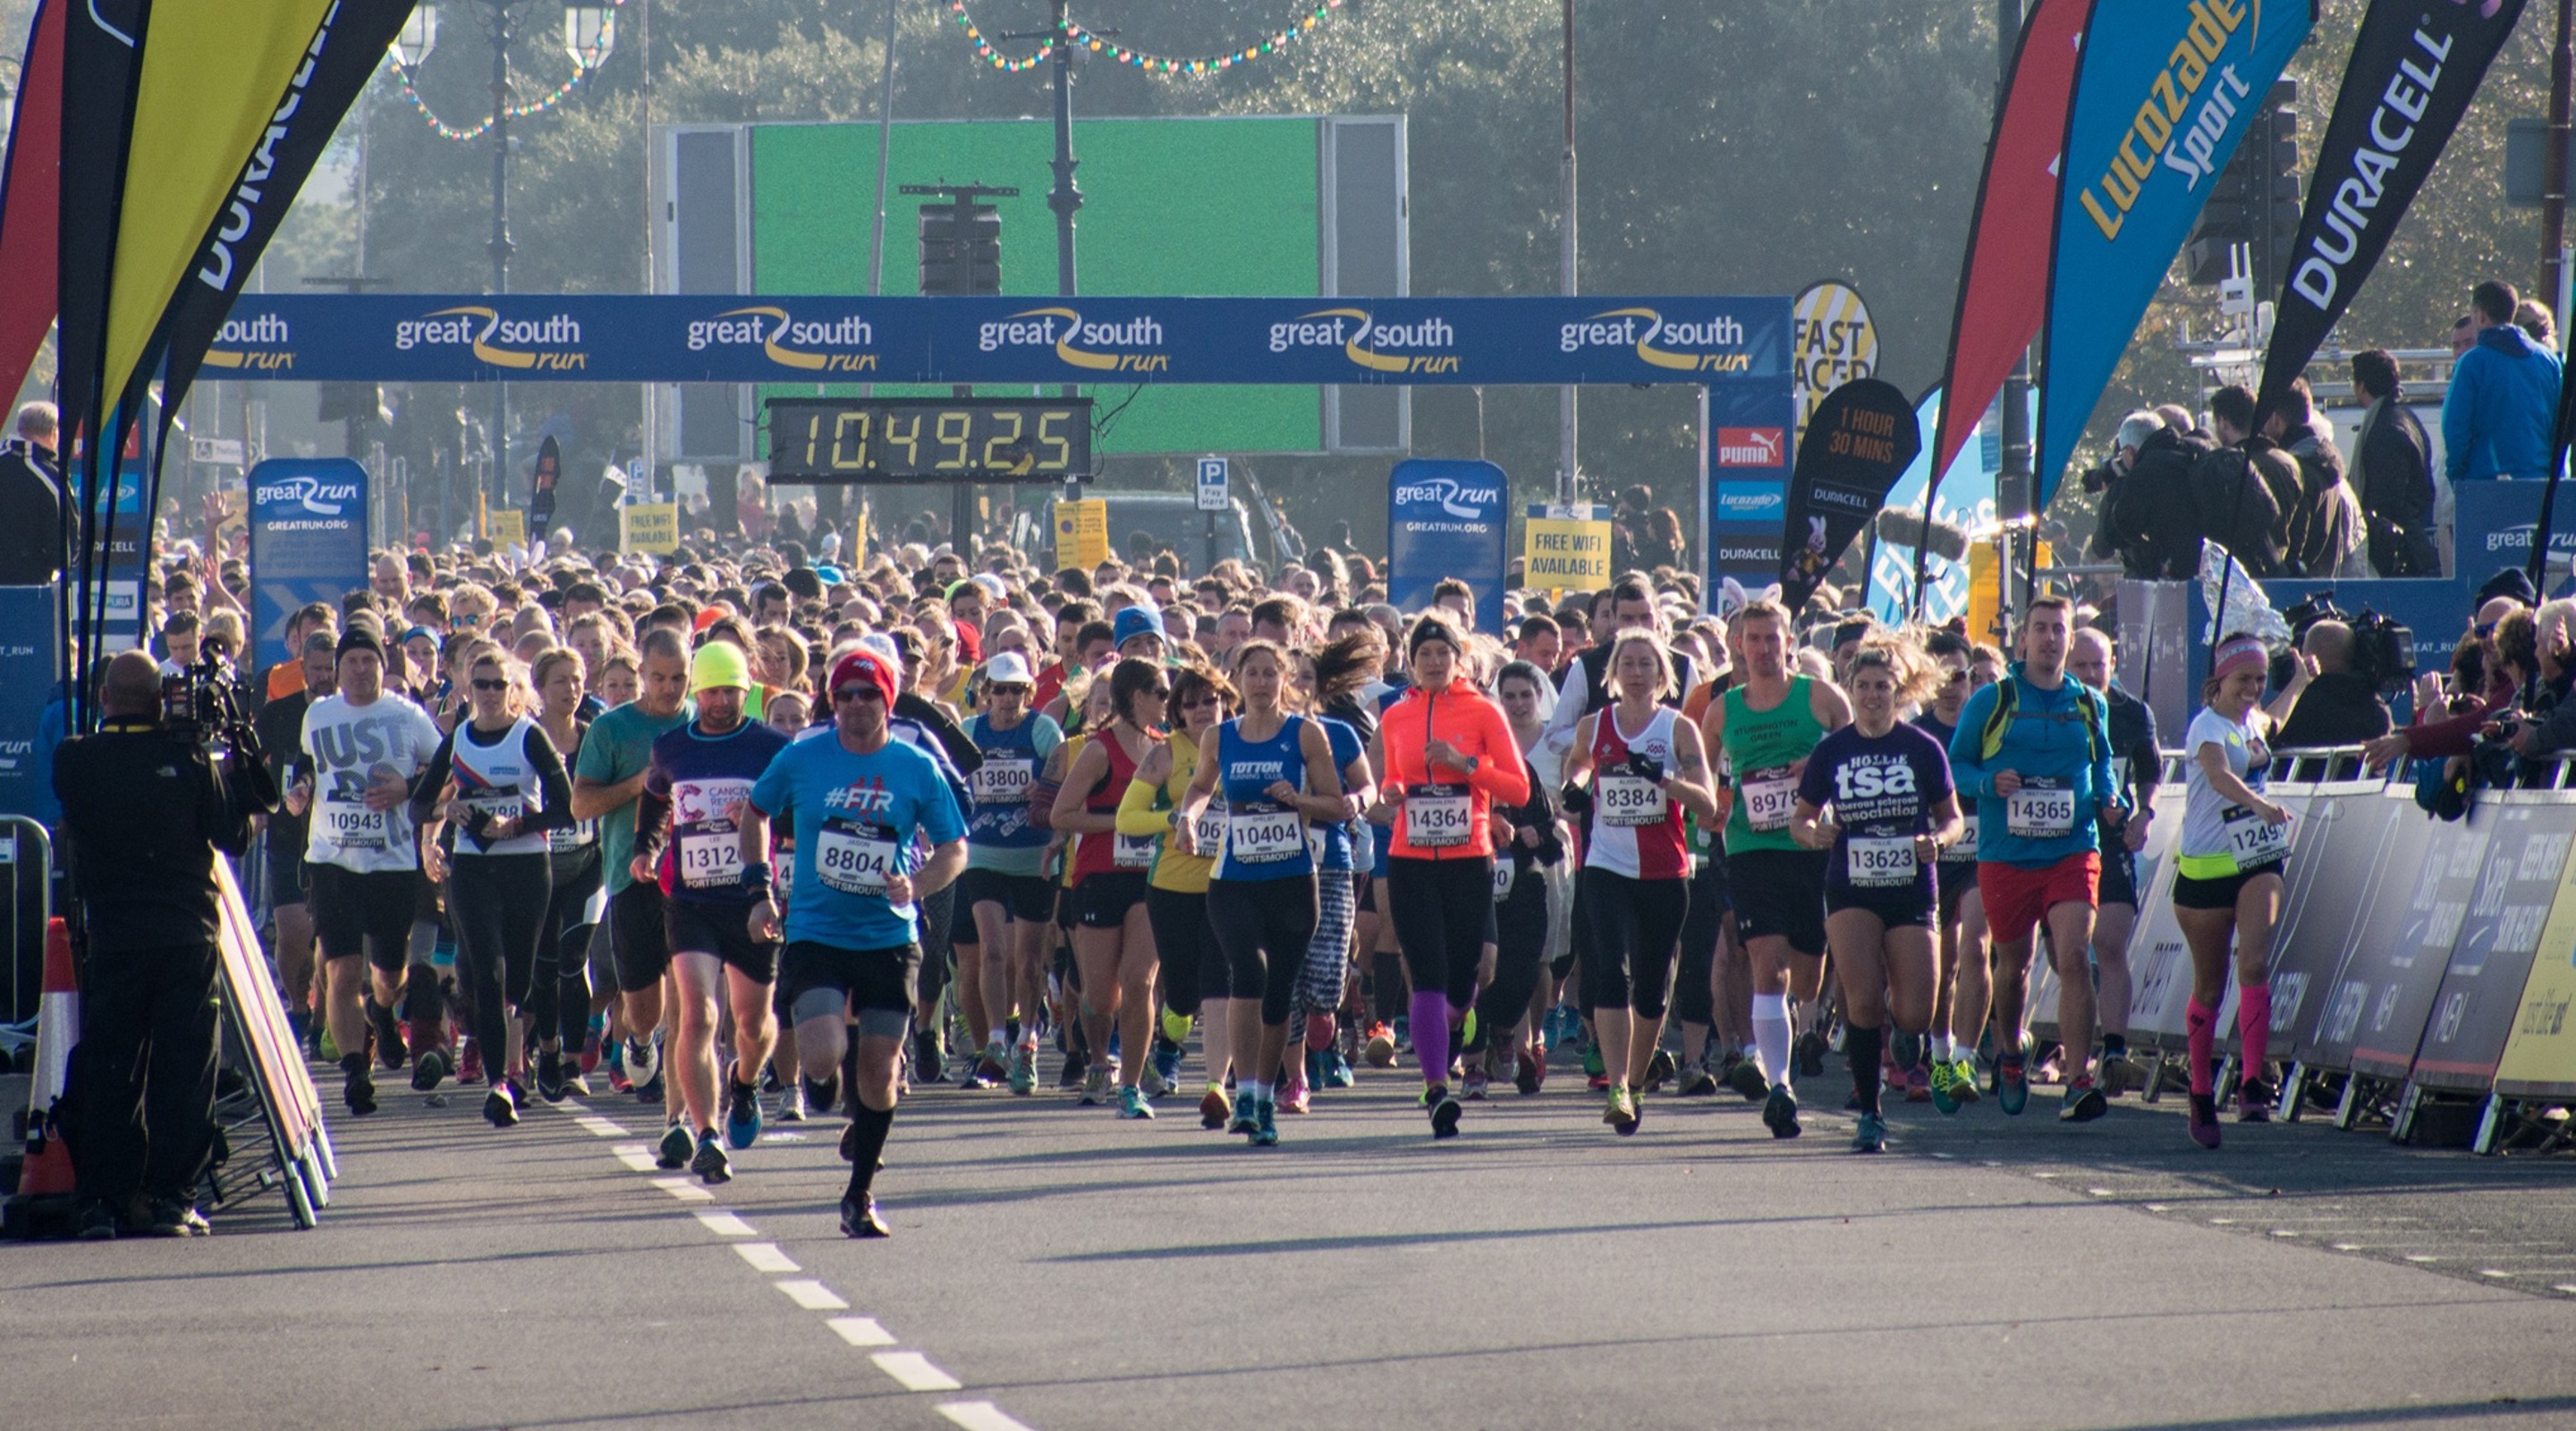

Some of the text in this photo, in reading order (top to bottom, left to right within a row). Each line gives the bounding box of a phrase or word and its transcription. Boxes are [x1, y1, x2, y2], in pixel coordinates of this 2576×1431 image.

[2080, 0, 2247, 242] Lucozade
[2164, 63, 2250, 193] Sport
[2292, 29, 2454, 312] DURACELL
[396, 314, 580, 350] great south
[688, 317, 872, 350] great south
[979, 317, 1162, 350] great south
[1270, 317, 1453, 352] great south
[1561, 317, 1743, 352] great south
[1794, 319, 1865, 357] FAST
[243, 352, 294, 369] run
[538, 352, 587, 369] run
[827, 354, 877, 372] run
[1120, 354, 1169, 372] run
[1411, 355, 1460, 374] run
[1700, 353, 1750, 371] run
[1794, 358, 1871, 394] ACED
[1852, 409, 1894, 437] HOUR
[804, 411, 1072, 470] 10.49.25
[1829, 431, 1894, 465] 30 MINS
[1720, 447, 1768, 463] PUMA
[1206, 463, 1222, 484] P
[256, 483, 357, 505] great run
[1205, 488, 1222, 497] Pay
[1395, 484, 1498, 505] great run
[1814, 488, 1868, 509] DURACELL
[267, 520, 348, 531] GREATRUN.ORG
[1406, 521, 1487, 534] GREATRUN.ORG
[1535, 533, 1601, 552] FREE WIFI
[2487, 529, 2576, 552] great ru
[1720, 548, 1781, 560] DURACELL
[1530, 557, 1605, 577] AVAILABLE
[311, 716, 409, 775] JUST
[1230, 762, 1284, 775] TOTTON
[1851, 754, 1909, 769] HOLLIE
[976, 770, 1029, 787] 13800
[1835, 764, 1917, 800] tsa
[824, 787, 894, 813] #FTR
[1606, 788, 1657, 808] 8384
[1410, 809, 1469, 828] 14364
[2012, 800, 2072, 820] 14365
[329, 813, 383, 830] 10943
[1603, 815, 1665, 826] PORTSMOUTH
[1236, 823, 1297, 846] 10404
[1408, 836, 1470, 847] PORTSMOUTH
[2009, 828, 2071, 838] PORTSMOUTH
[686, 844, 741, 869] 1312
[825, 846, 884, 876] 8804
[1236, 851, 1300, 865] PORTSMOUTH
[1852, 849, 1912, 868] 13623
[2238, 851, 2293, 872] PORTSMOUT
[685, 875, 742, 889] PORTSMOU
[1850, 878, 1913, 887] PORTSMOUTH
[2434, 991, 2470, 1043] MEN
